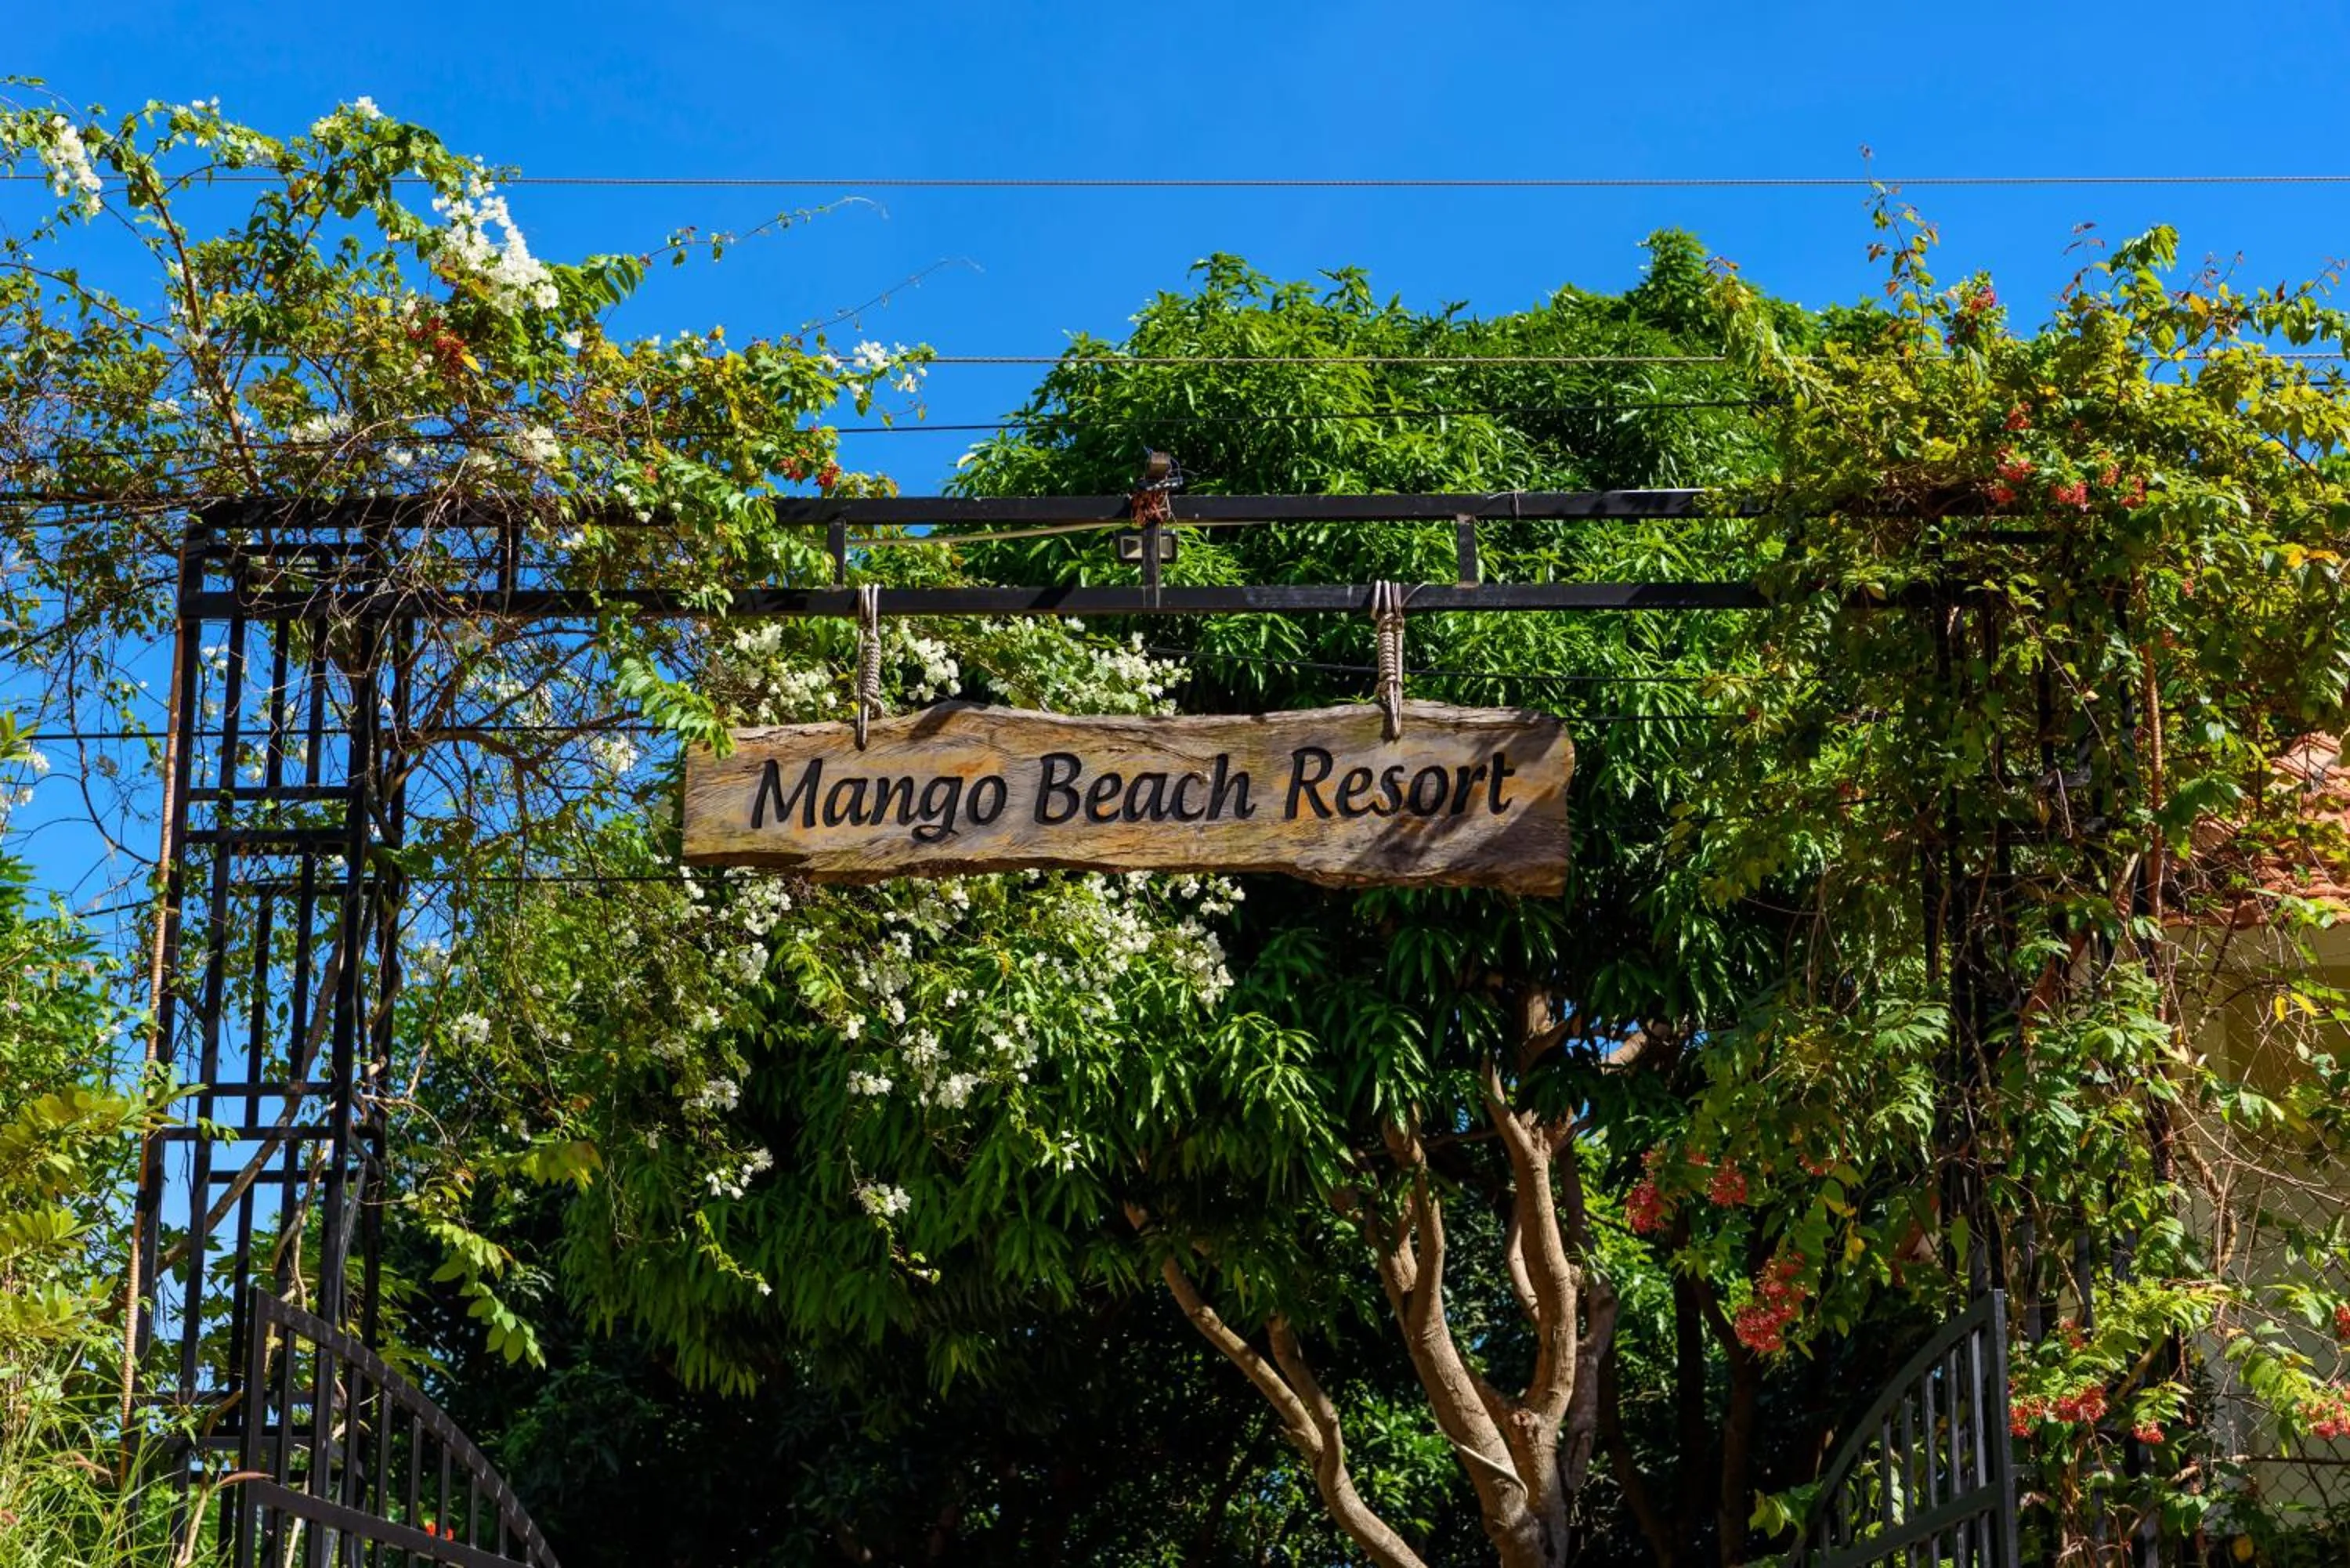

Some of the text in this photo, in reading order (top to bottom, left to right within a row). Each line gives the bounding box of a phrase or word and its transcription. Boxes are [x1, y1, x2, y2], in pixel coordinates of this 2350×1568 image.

[750, 746, 1516, 844] Mango Beach Resort
